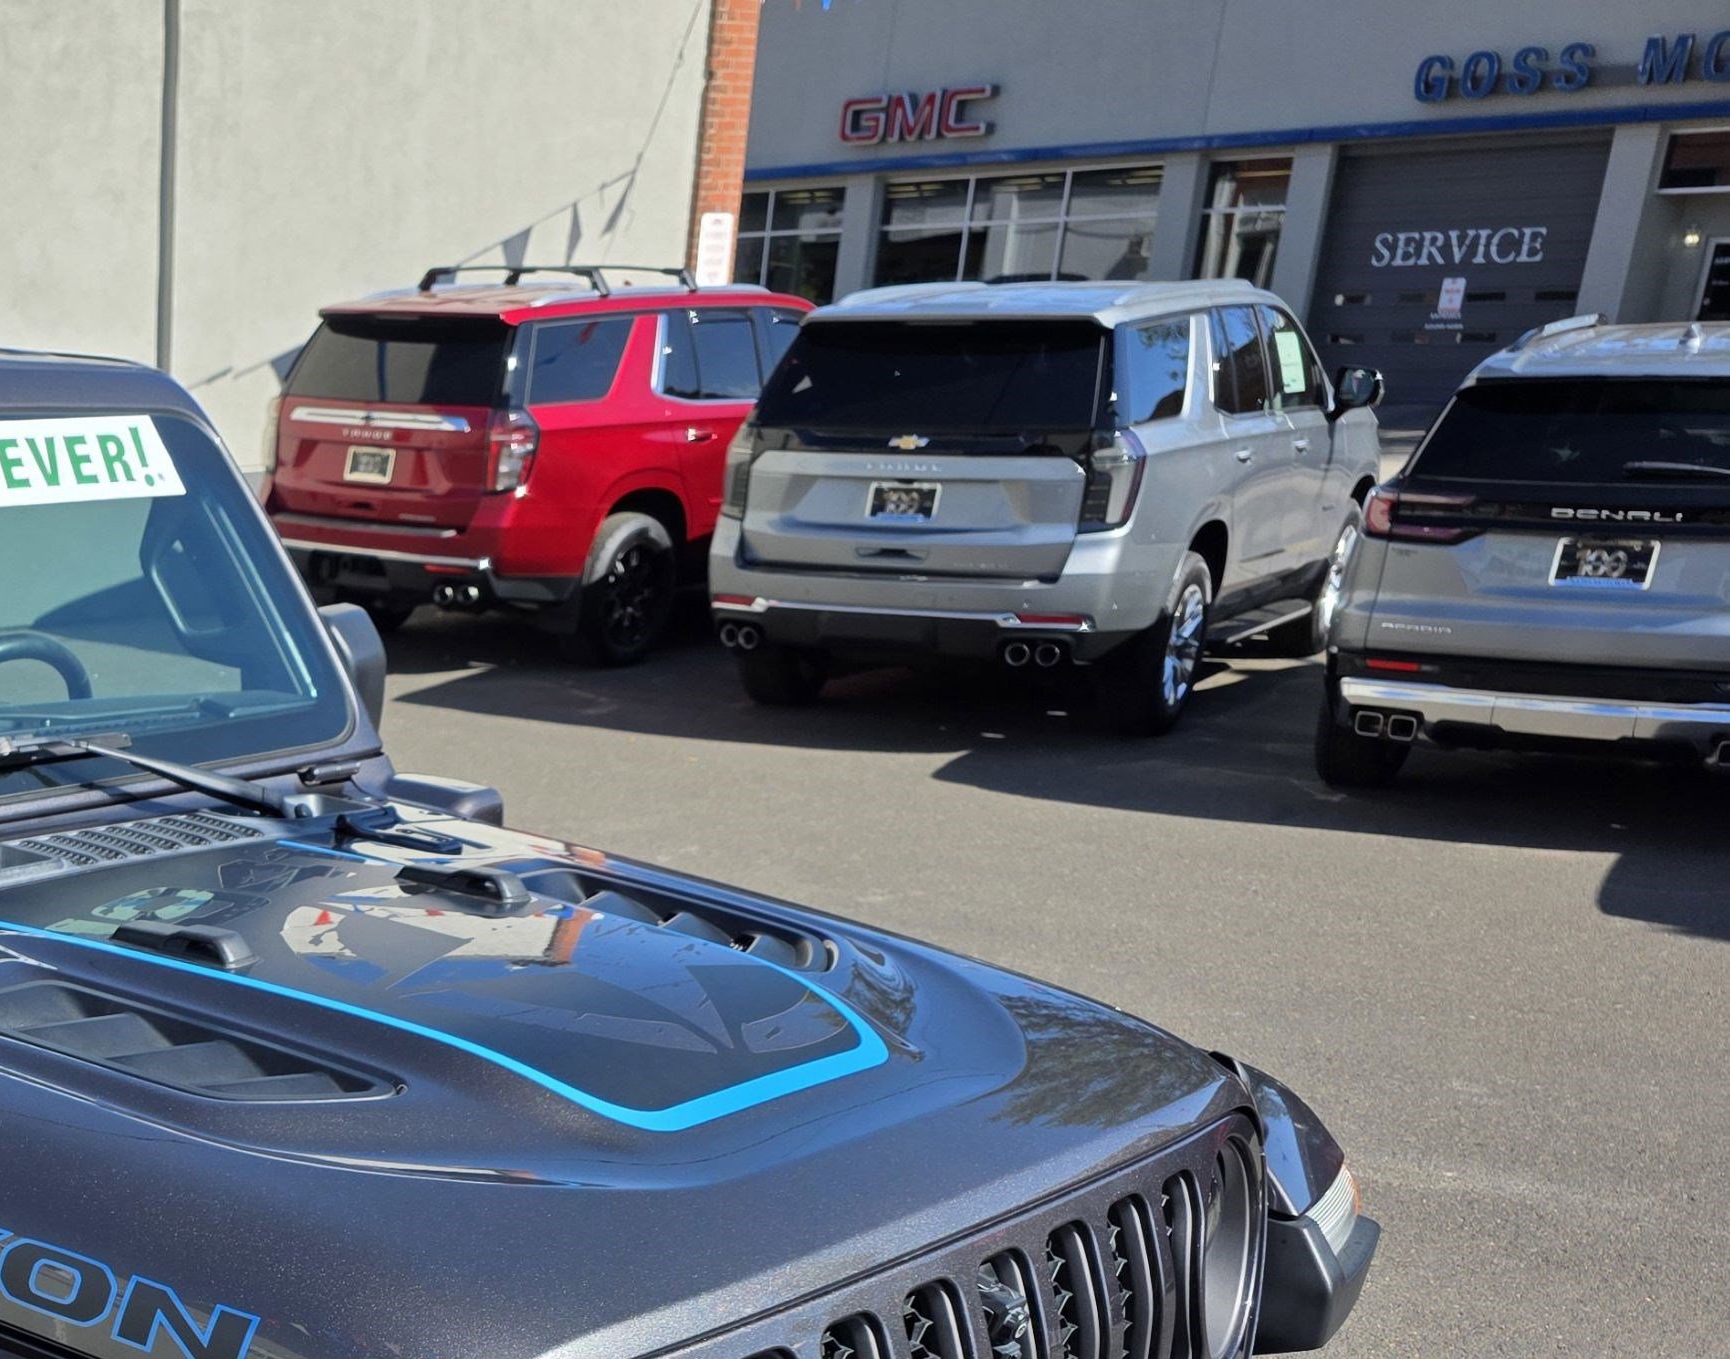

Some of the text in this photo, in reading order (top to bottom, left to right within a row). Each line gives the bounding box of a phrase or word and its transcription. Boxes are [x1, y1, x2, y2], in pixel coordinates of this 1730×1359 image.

[1414, 42, 1597, 102] GOSS
[838, 84, 996, 146] GMC
[1370, 227, 1548, 267] SERVICE
[1550, 507, 1683, 522] DENALI
